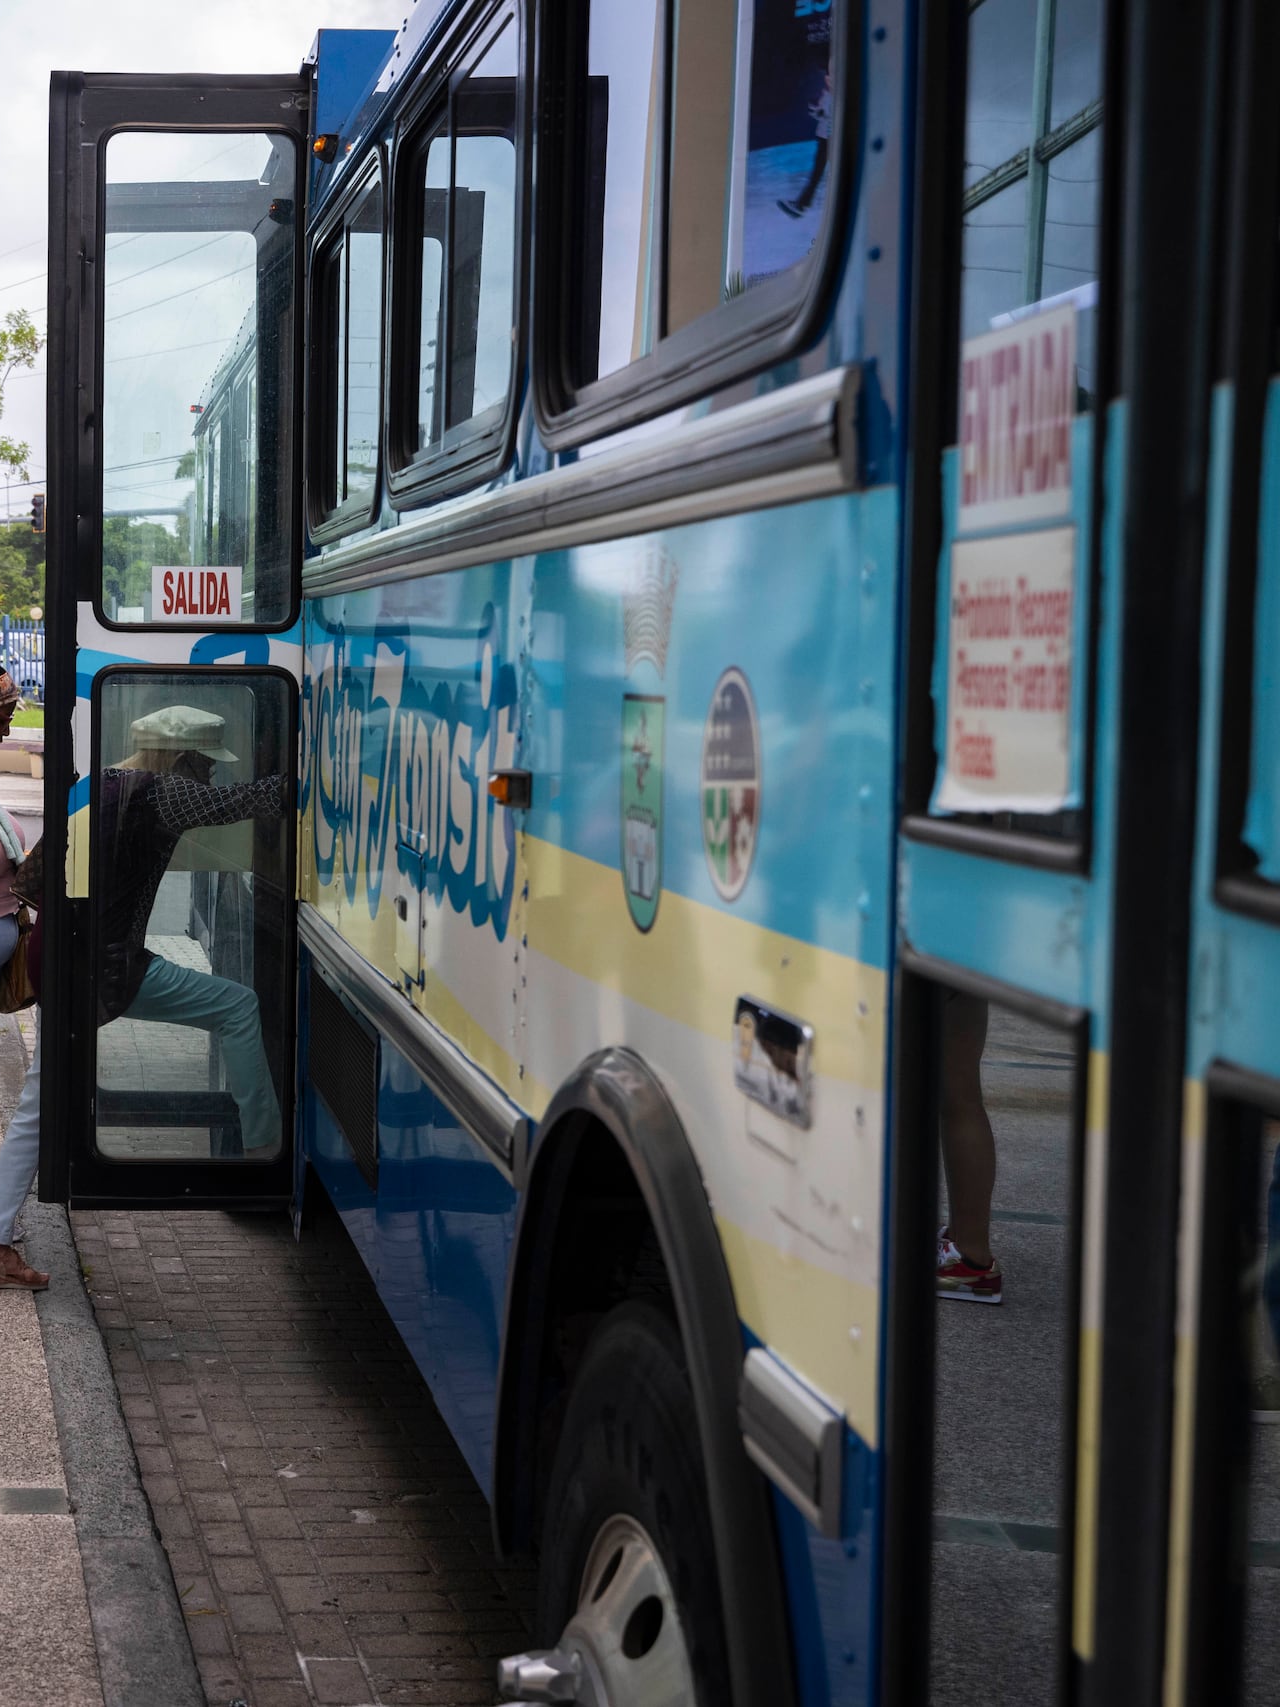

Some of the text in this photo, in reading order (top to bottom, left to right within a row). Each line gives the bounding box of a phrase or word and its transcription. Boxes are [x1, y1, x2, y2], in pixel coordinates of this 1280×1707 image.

[162, 570, 231, 615] SALIDA
[319, 645, 362, 880] City
[372, 641, 516, 899] Transit
